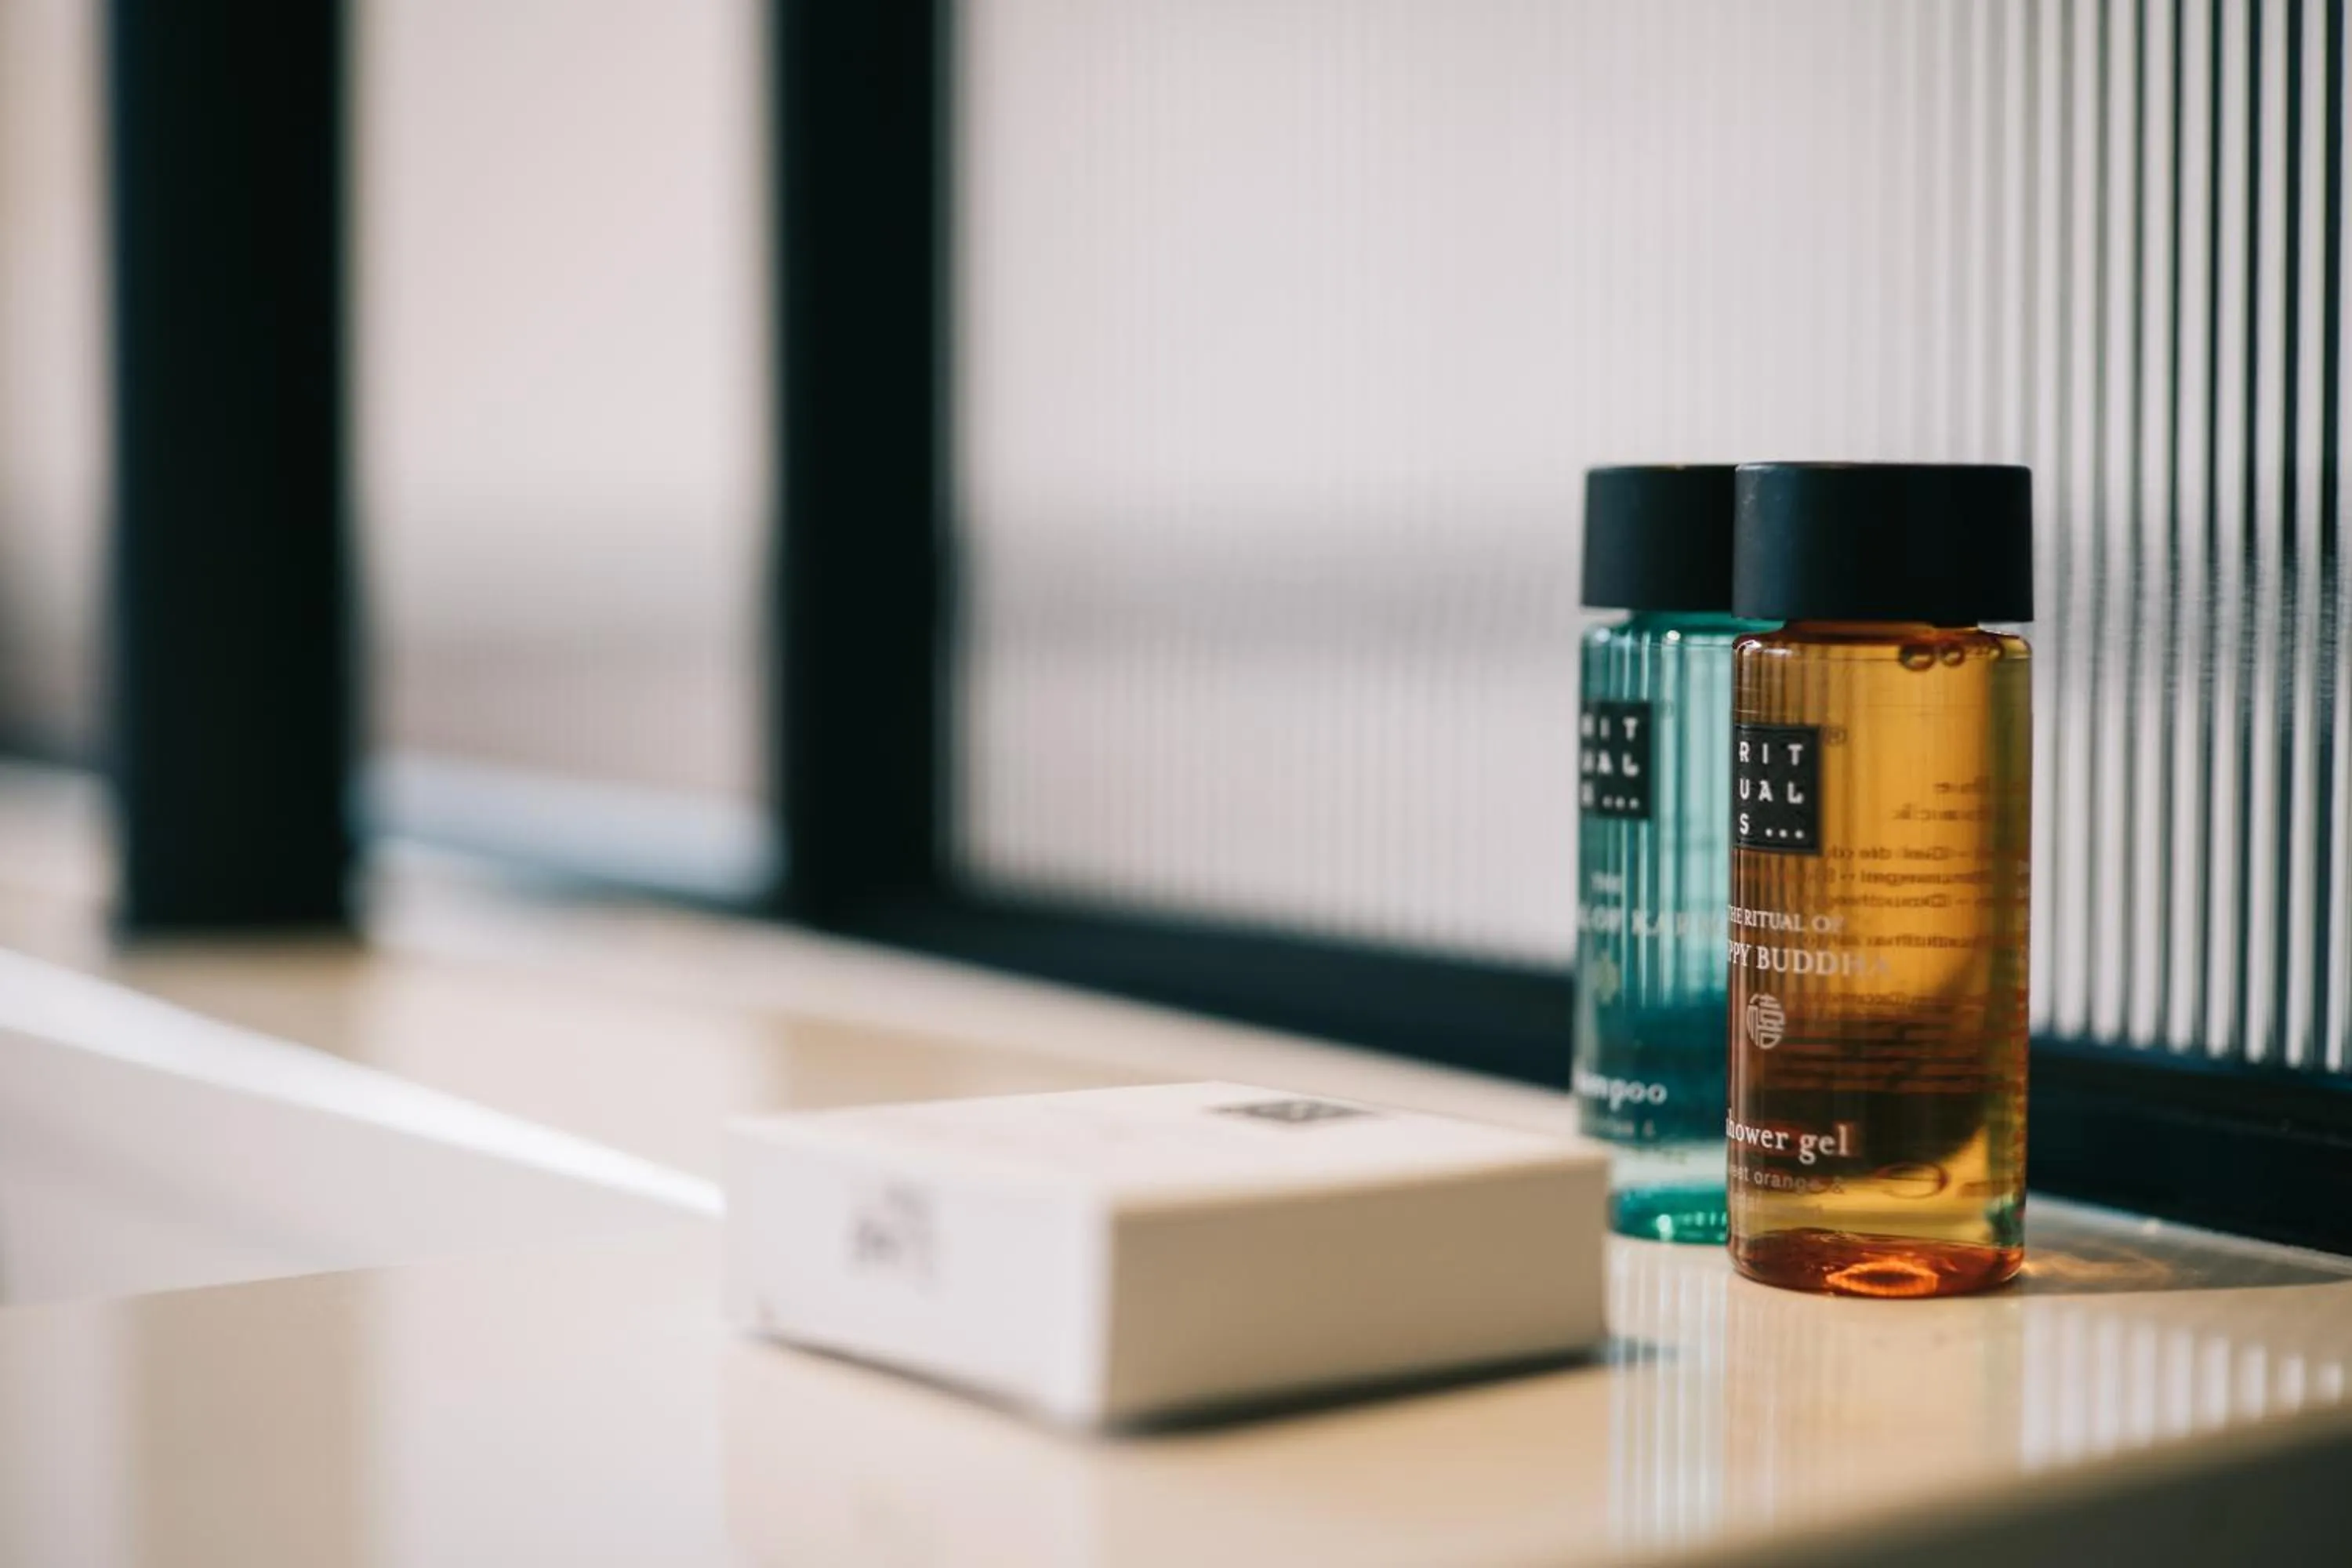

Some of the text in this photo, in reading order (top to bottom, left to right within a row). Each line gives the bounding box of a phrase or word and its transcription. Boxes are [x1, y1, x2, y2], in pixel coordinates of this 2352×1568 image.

[1739, 741, 1803, 766] RIT
[1739, 778, 1804, 804] UAL
[1744, 909, 1806, 932] RITUAL
[1798, 1124, 1849, 1165] gel
